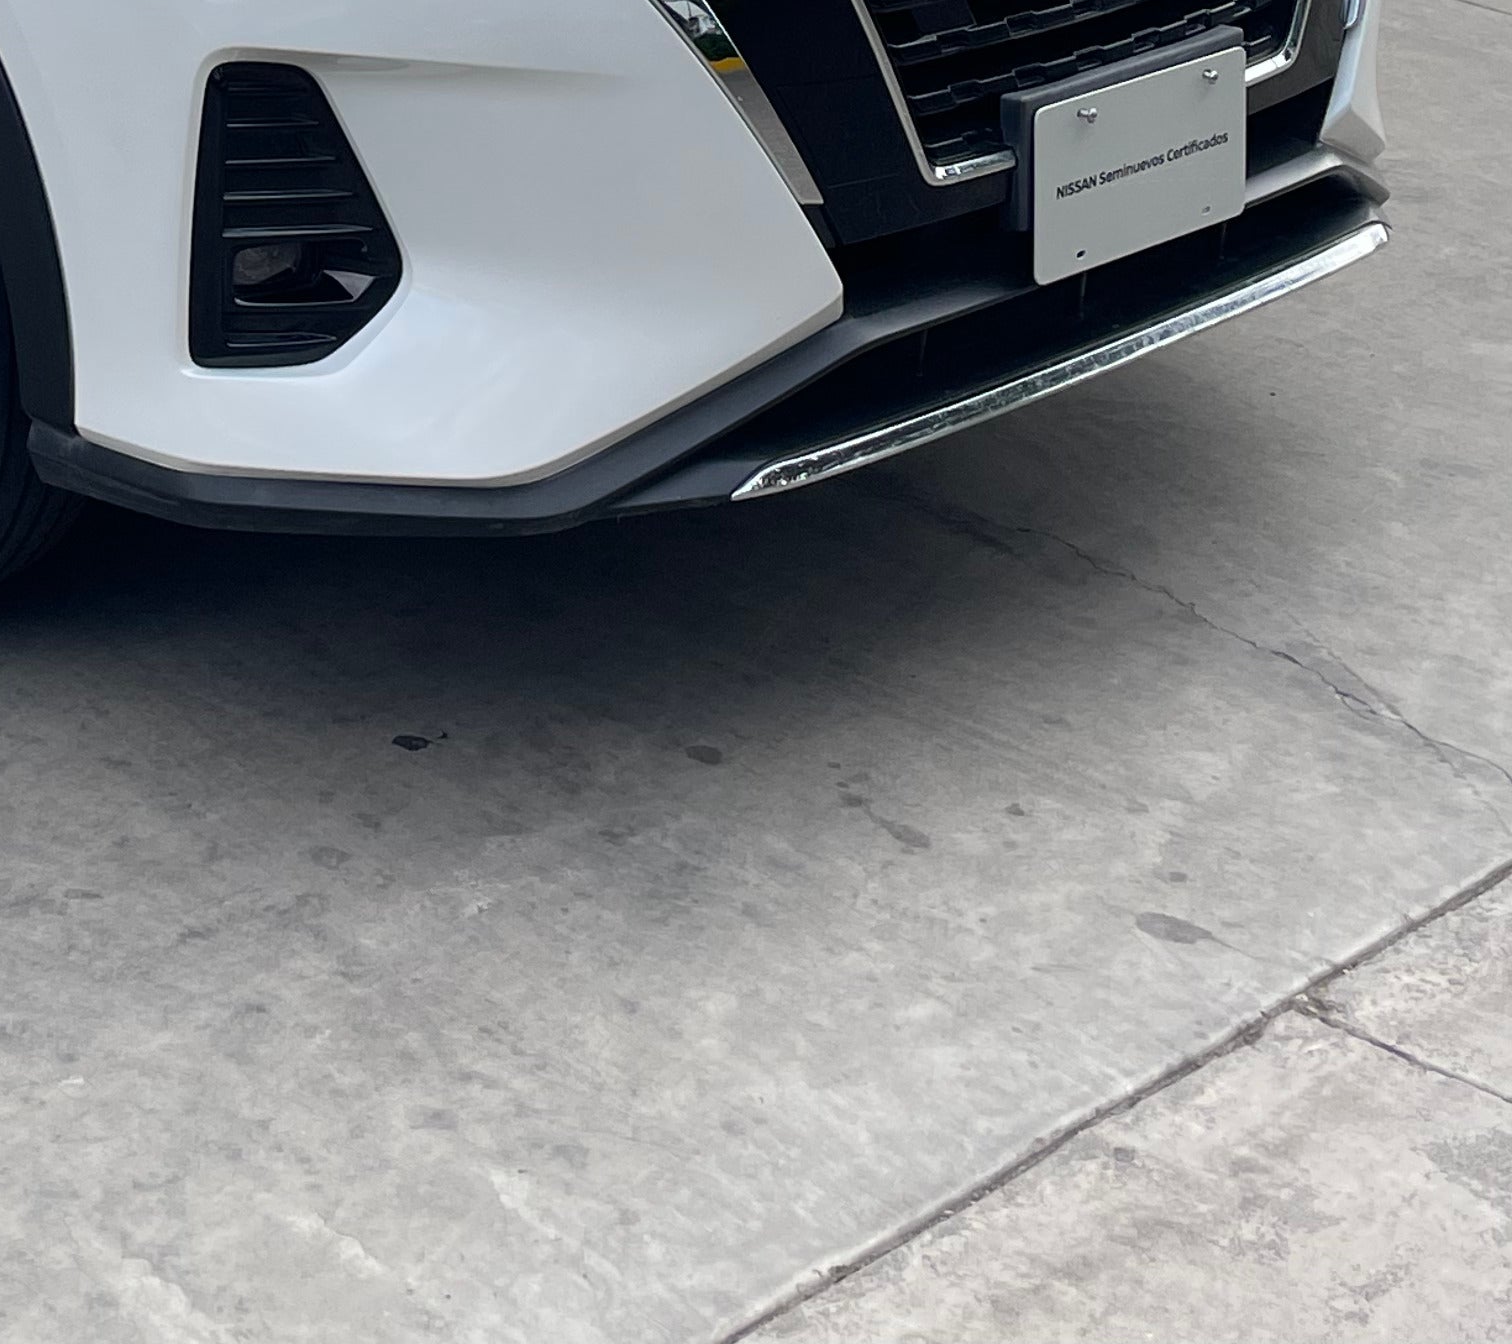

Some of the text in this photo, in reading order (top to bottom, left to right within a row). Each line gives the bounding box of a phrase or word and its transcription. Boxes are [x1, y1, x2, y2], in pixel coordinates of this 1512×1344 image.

[1055, 131, 1230, 200] NISSAN Seminuevos Certificados
